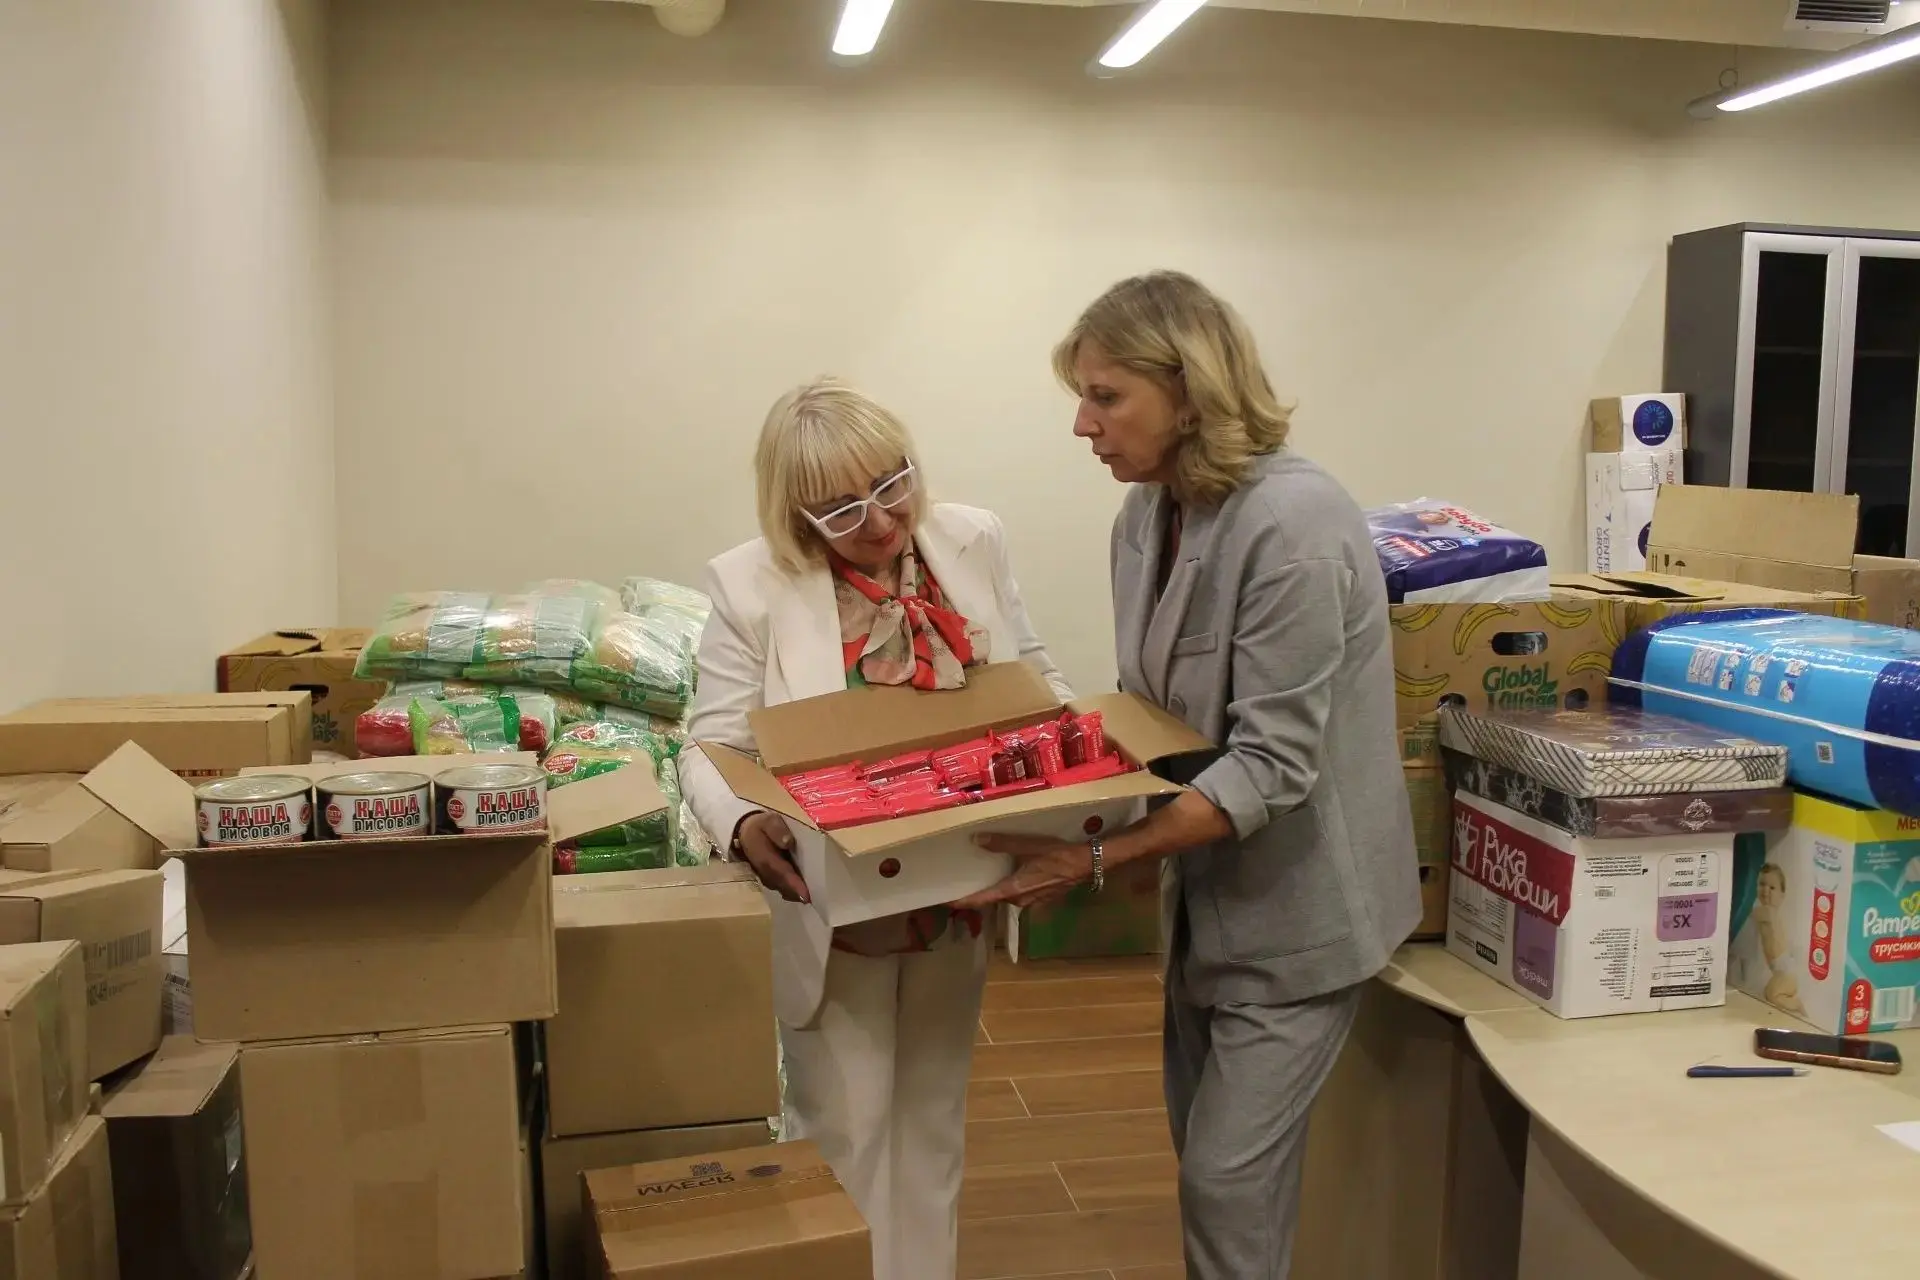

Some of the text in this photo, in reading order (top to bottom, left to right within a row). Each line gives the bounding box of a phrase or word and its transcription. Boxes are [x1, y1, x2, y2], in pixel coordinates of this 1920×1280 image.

[1482, 661, 1552, 693] Global
[355, 794, 419, 819] КАША
[478, 787, 539, 813] КАША
[219, 803, 288, 828] КАША
[1672, 913, 1693, 929] XS
[1874, 940, 1920, 957] трусики
[1855, 985, 1865, 1001] 3
